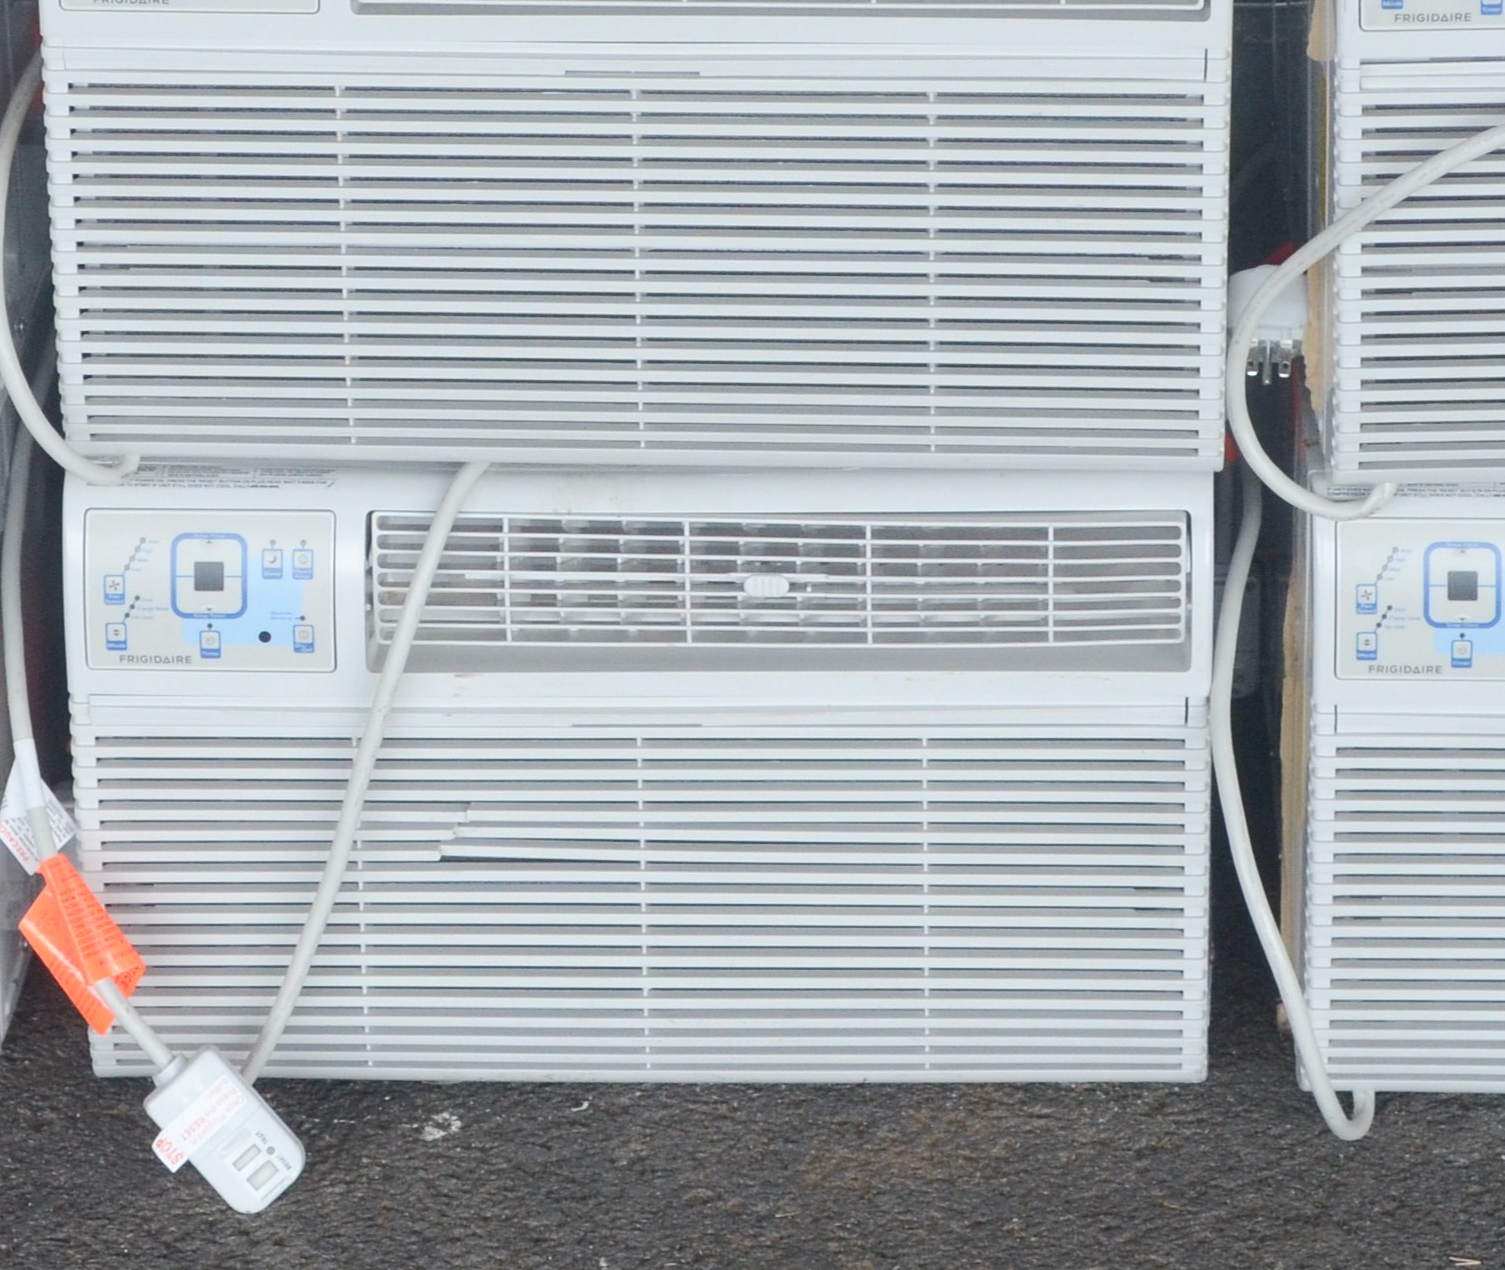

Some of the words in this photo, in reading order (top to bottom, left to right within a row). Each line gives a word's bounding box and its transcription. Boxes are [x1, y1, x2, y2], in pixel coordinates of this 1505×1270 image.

[1394, 12, 1472, 23] FRIGIDAIRE
[118, 654, 193, 664] FRIGIDAIRE
[1368, 665, 1443, 674] FRIGIDAIRE
[154, 1134, 185, 1166] STOP
